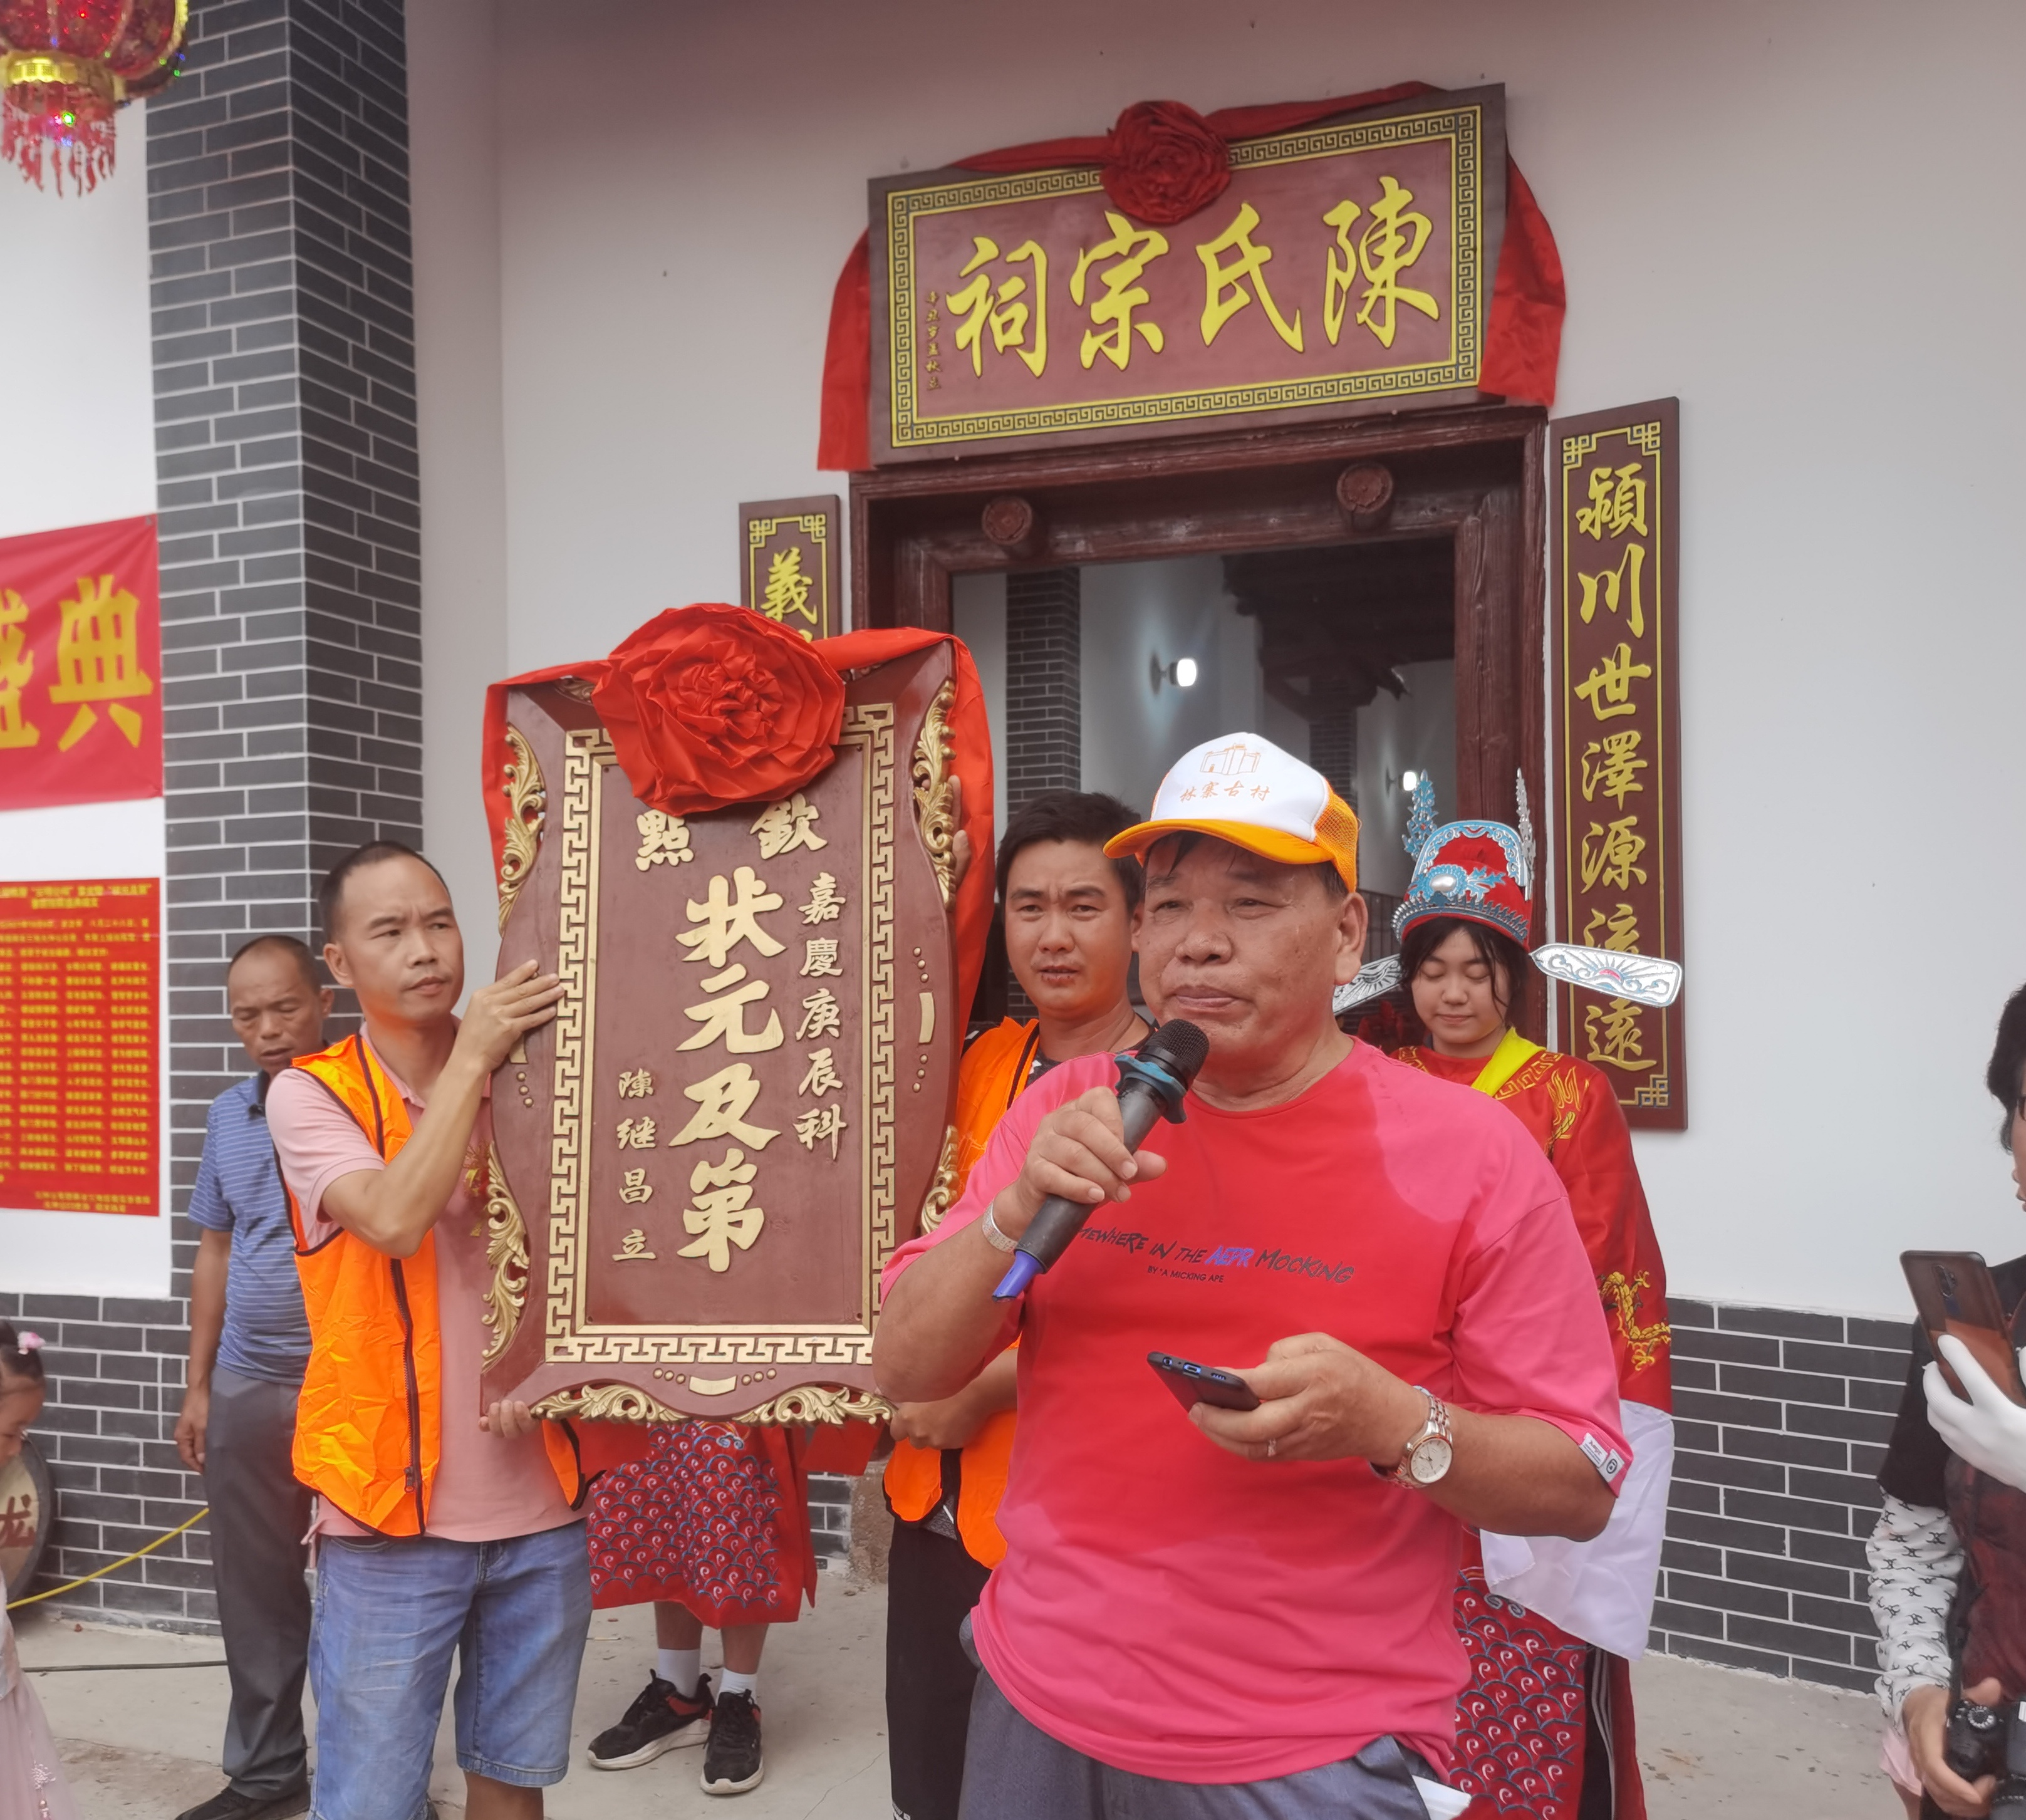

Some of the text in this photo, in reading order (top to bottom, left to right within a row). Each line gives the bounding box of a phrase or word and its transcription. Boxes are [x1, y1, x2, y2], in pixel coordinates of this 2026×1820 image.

[945, 175, 1440, 378] 陳氏宗祠
[760, 546, 818, 643] 義
[1148, 1265, 1159, 1274] BY
[1208, 1274, 1225, 1283] APE
[1149, 1240, 1178, 1259] IN
[1174, 1247, 1208, 1264] THE
